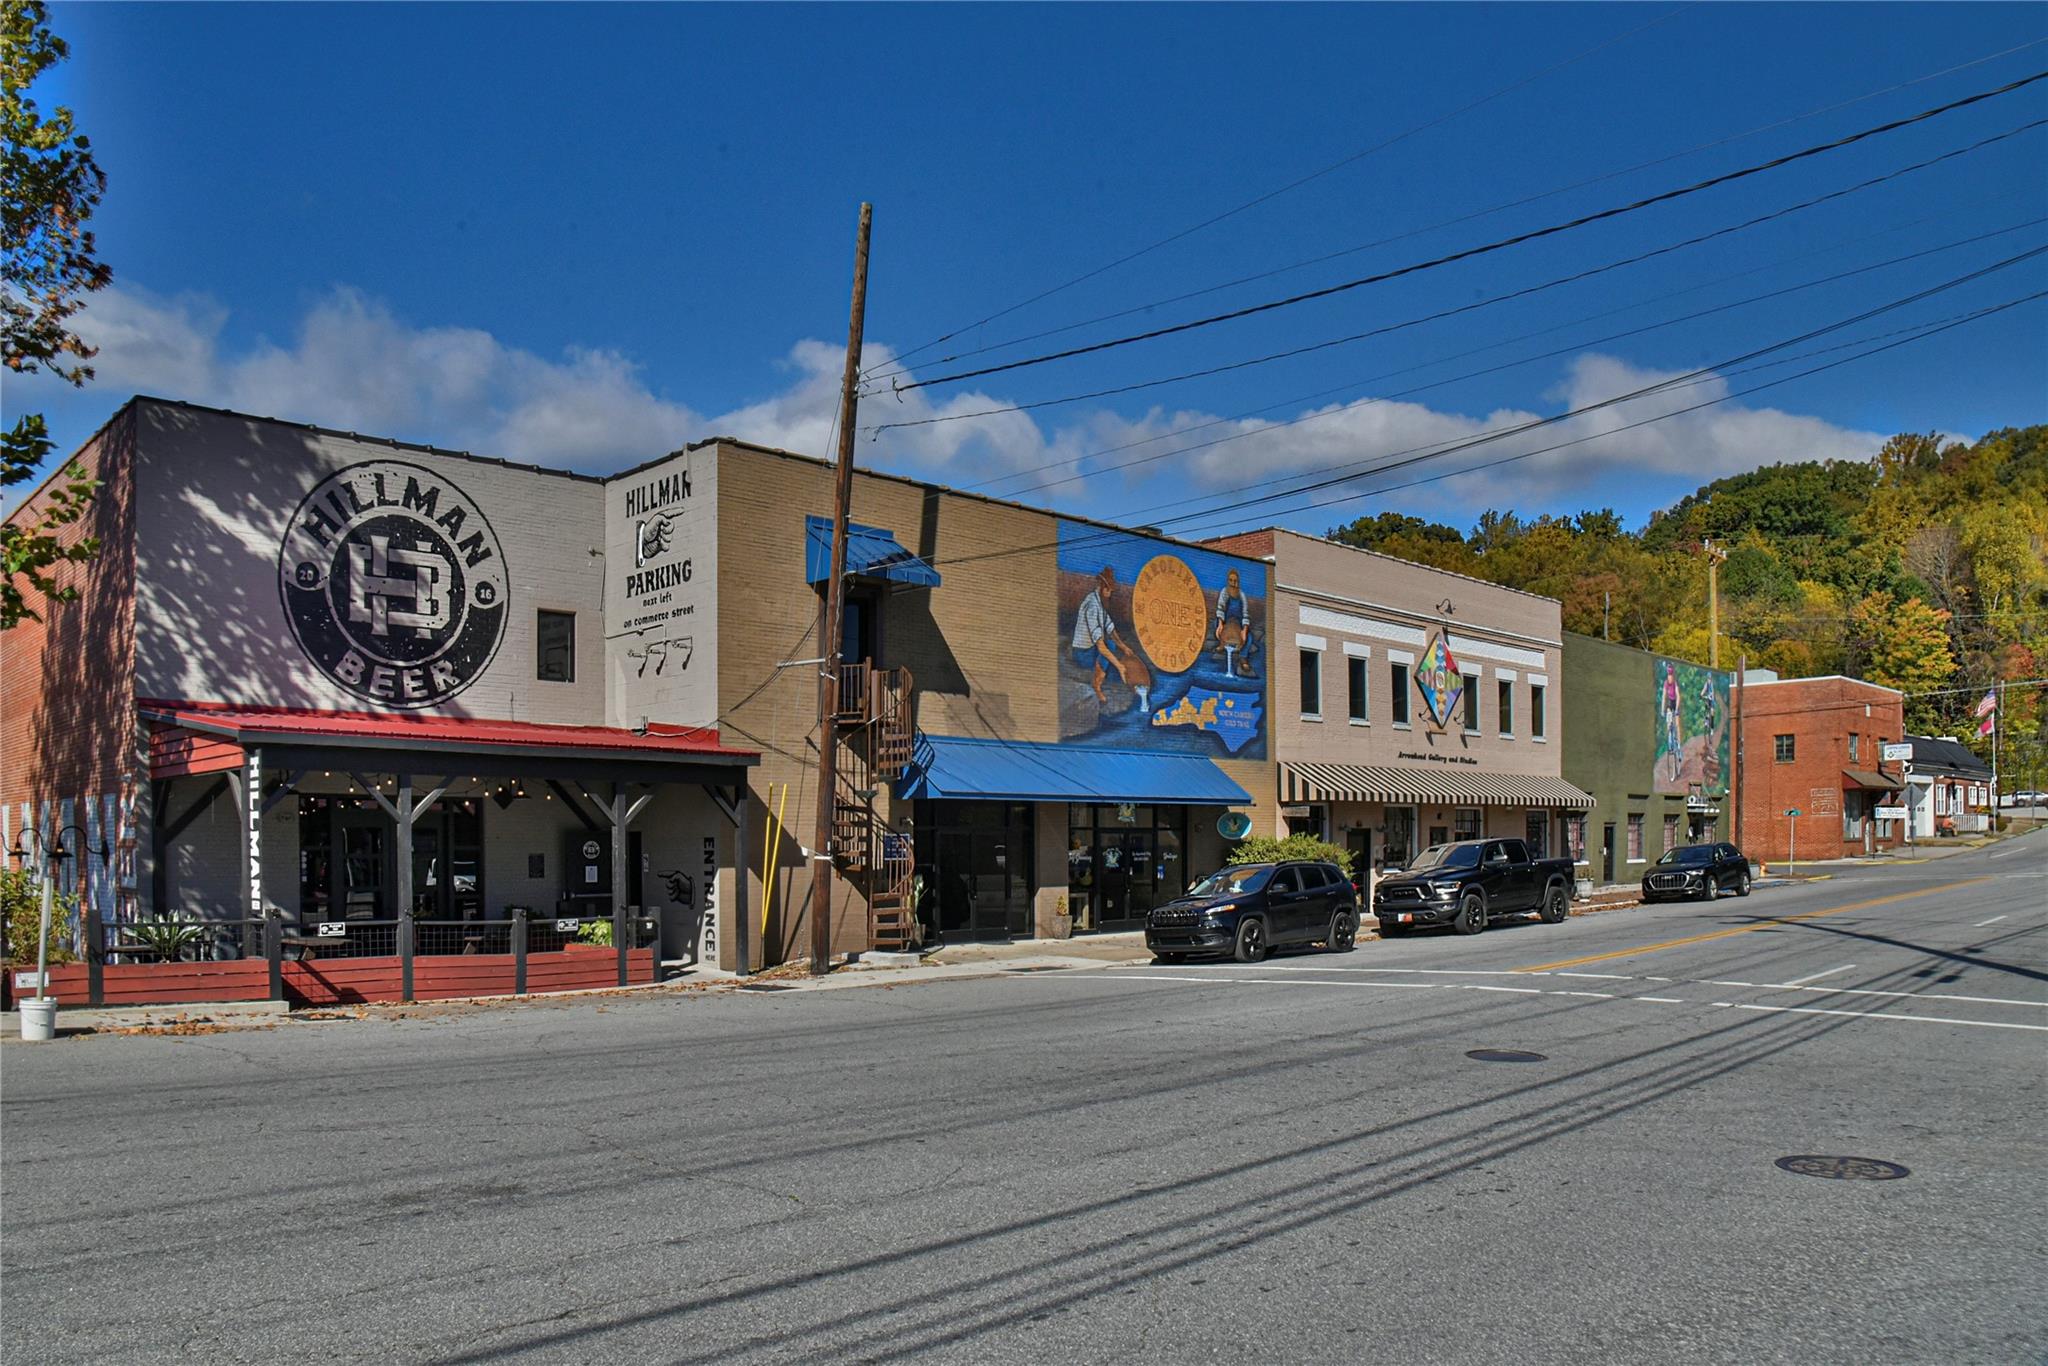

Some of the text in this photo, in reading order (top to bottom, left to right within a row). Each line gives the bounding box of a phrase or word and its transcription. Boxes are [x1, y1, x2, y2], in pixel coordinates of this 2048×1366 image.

[626, 470, 692, 518] HILLMAN
[302, 472, 493, 569] HILLMAN
[299, 569, 315, 582] 20
[480, 588, 493, 600] 16
[626, 557, 692, 598] PARKING
[624, 605, 694, 628] on commerce street
[643, 591, 672, 607] next left
[1149, 597, 1192, 628] ONE
[333, 650, 462, 699] BEER
[249, 756, 260, 899] HILLMAN
[703, 836, 716, 952] ENTRANCE
